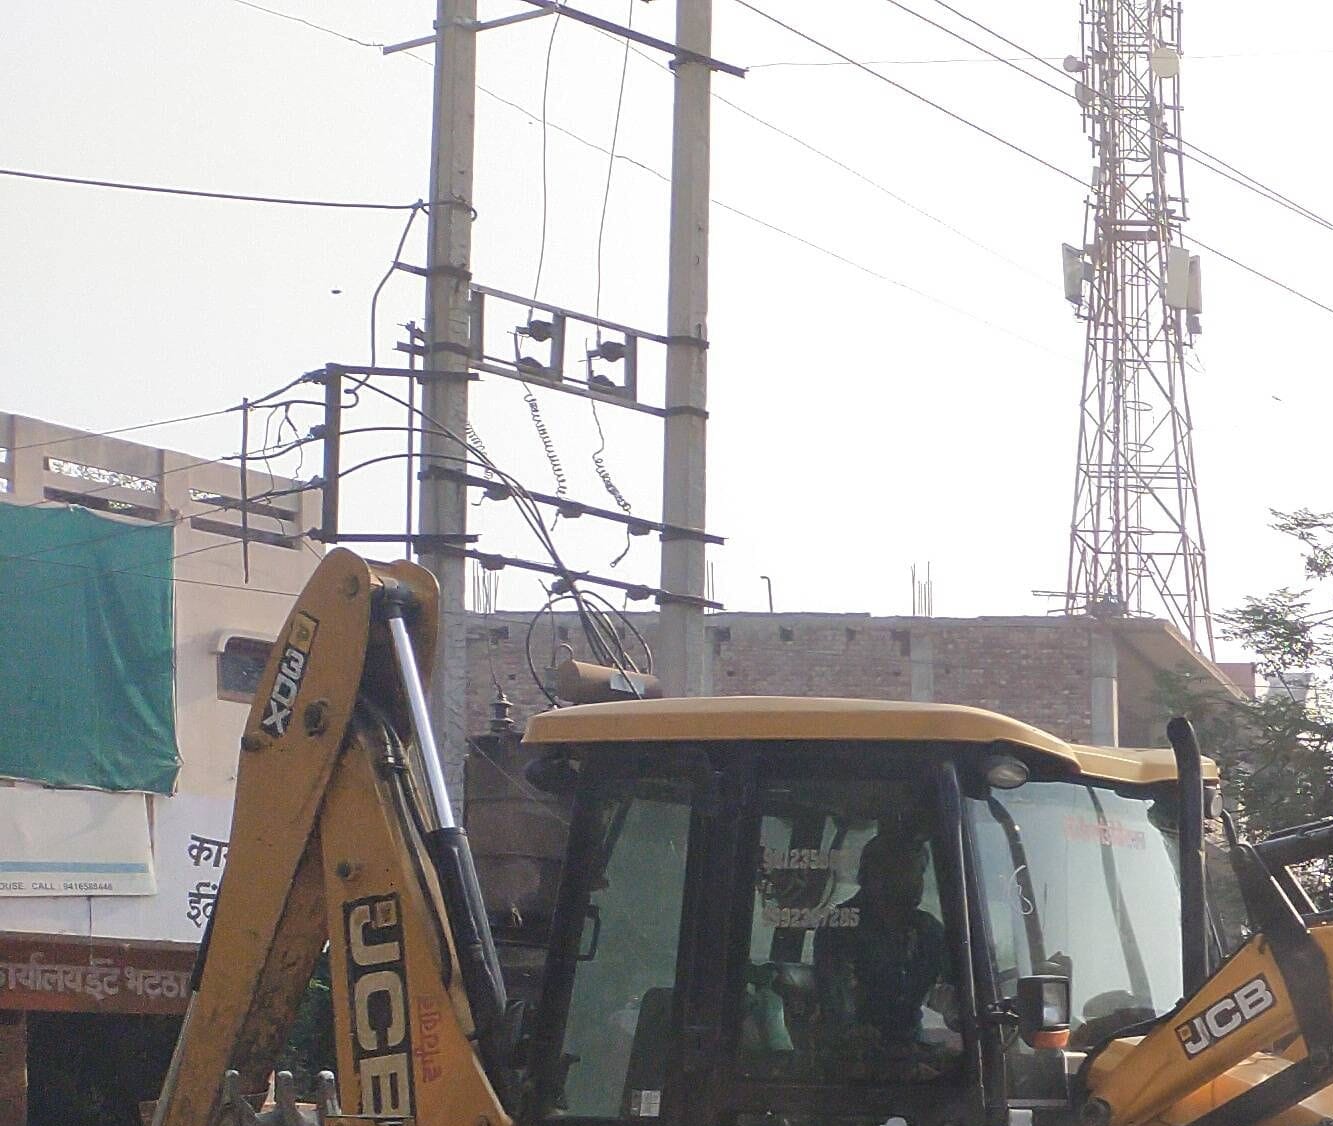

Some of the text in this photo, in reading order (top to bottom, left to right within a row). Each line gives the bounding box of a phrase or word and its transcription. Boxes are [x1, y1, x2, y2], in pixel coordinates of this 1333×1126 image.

[262, 647, 305, 737] 3DX
[188, 834, 229, 868] का
[31, 881, 55, 891] CALL
[1179, 979, 1273, 1054] JCB
